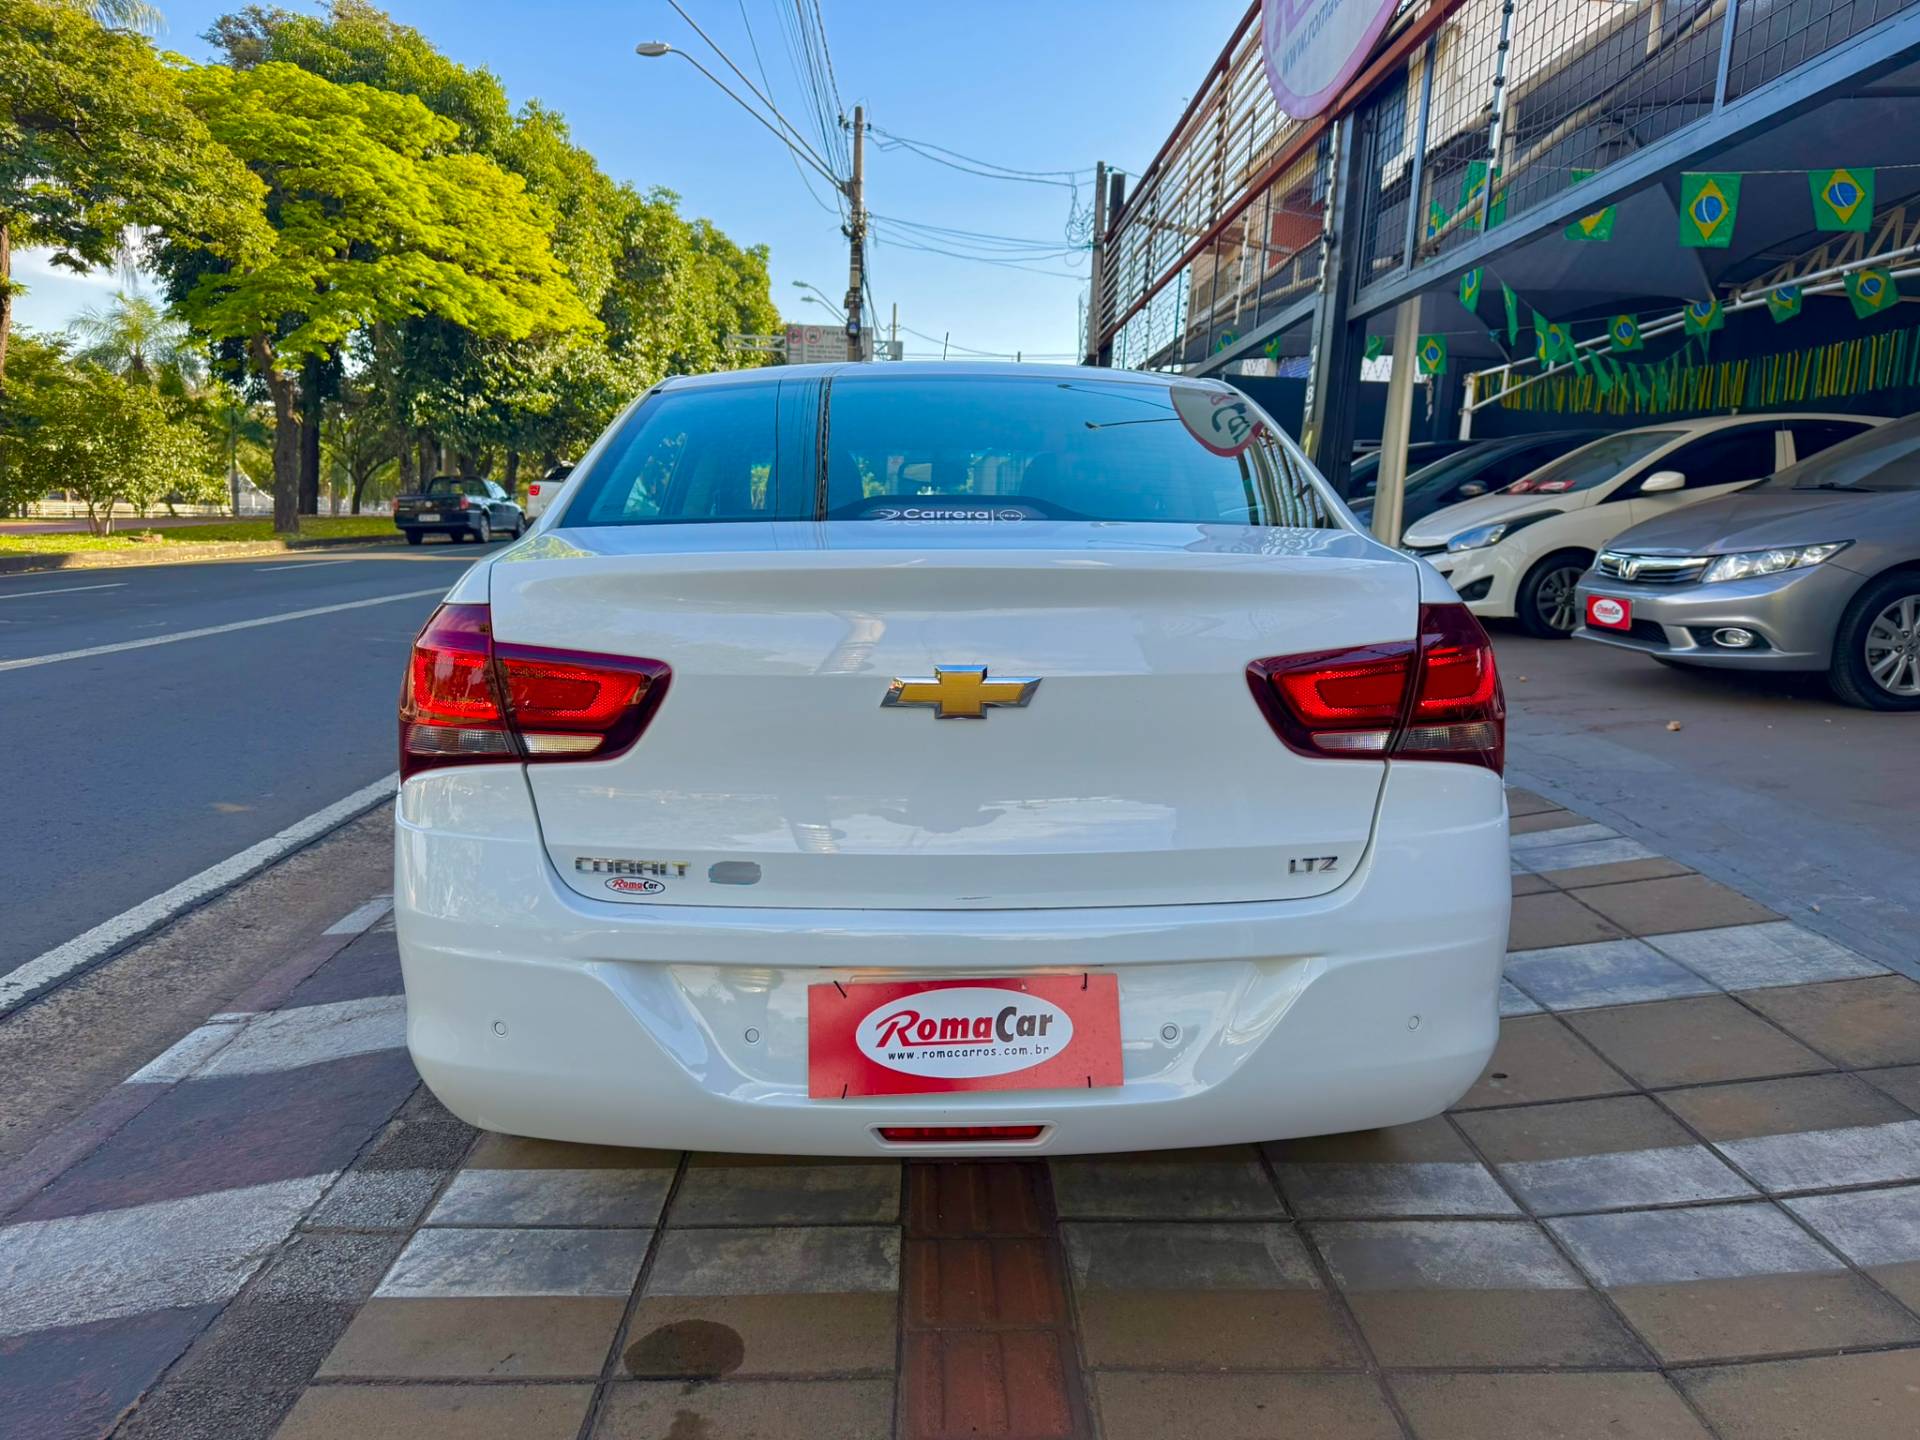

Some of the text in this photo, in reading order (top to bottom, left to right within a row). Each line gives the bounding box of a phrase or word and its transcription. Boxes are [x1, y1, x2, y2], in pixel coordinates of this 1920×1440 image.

[903, 508, 989, 519] Carrera
[575, 857, 689, 879] COBALT
[1289, 856, 1338, 874] LTZ
[875, 1006, 1053, 1048] RomaCar
[888, 1044, 1050, 1060] www.romacarros.com.br
